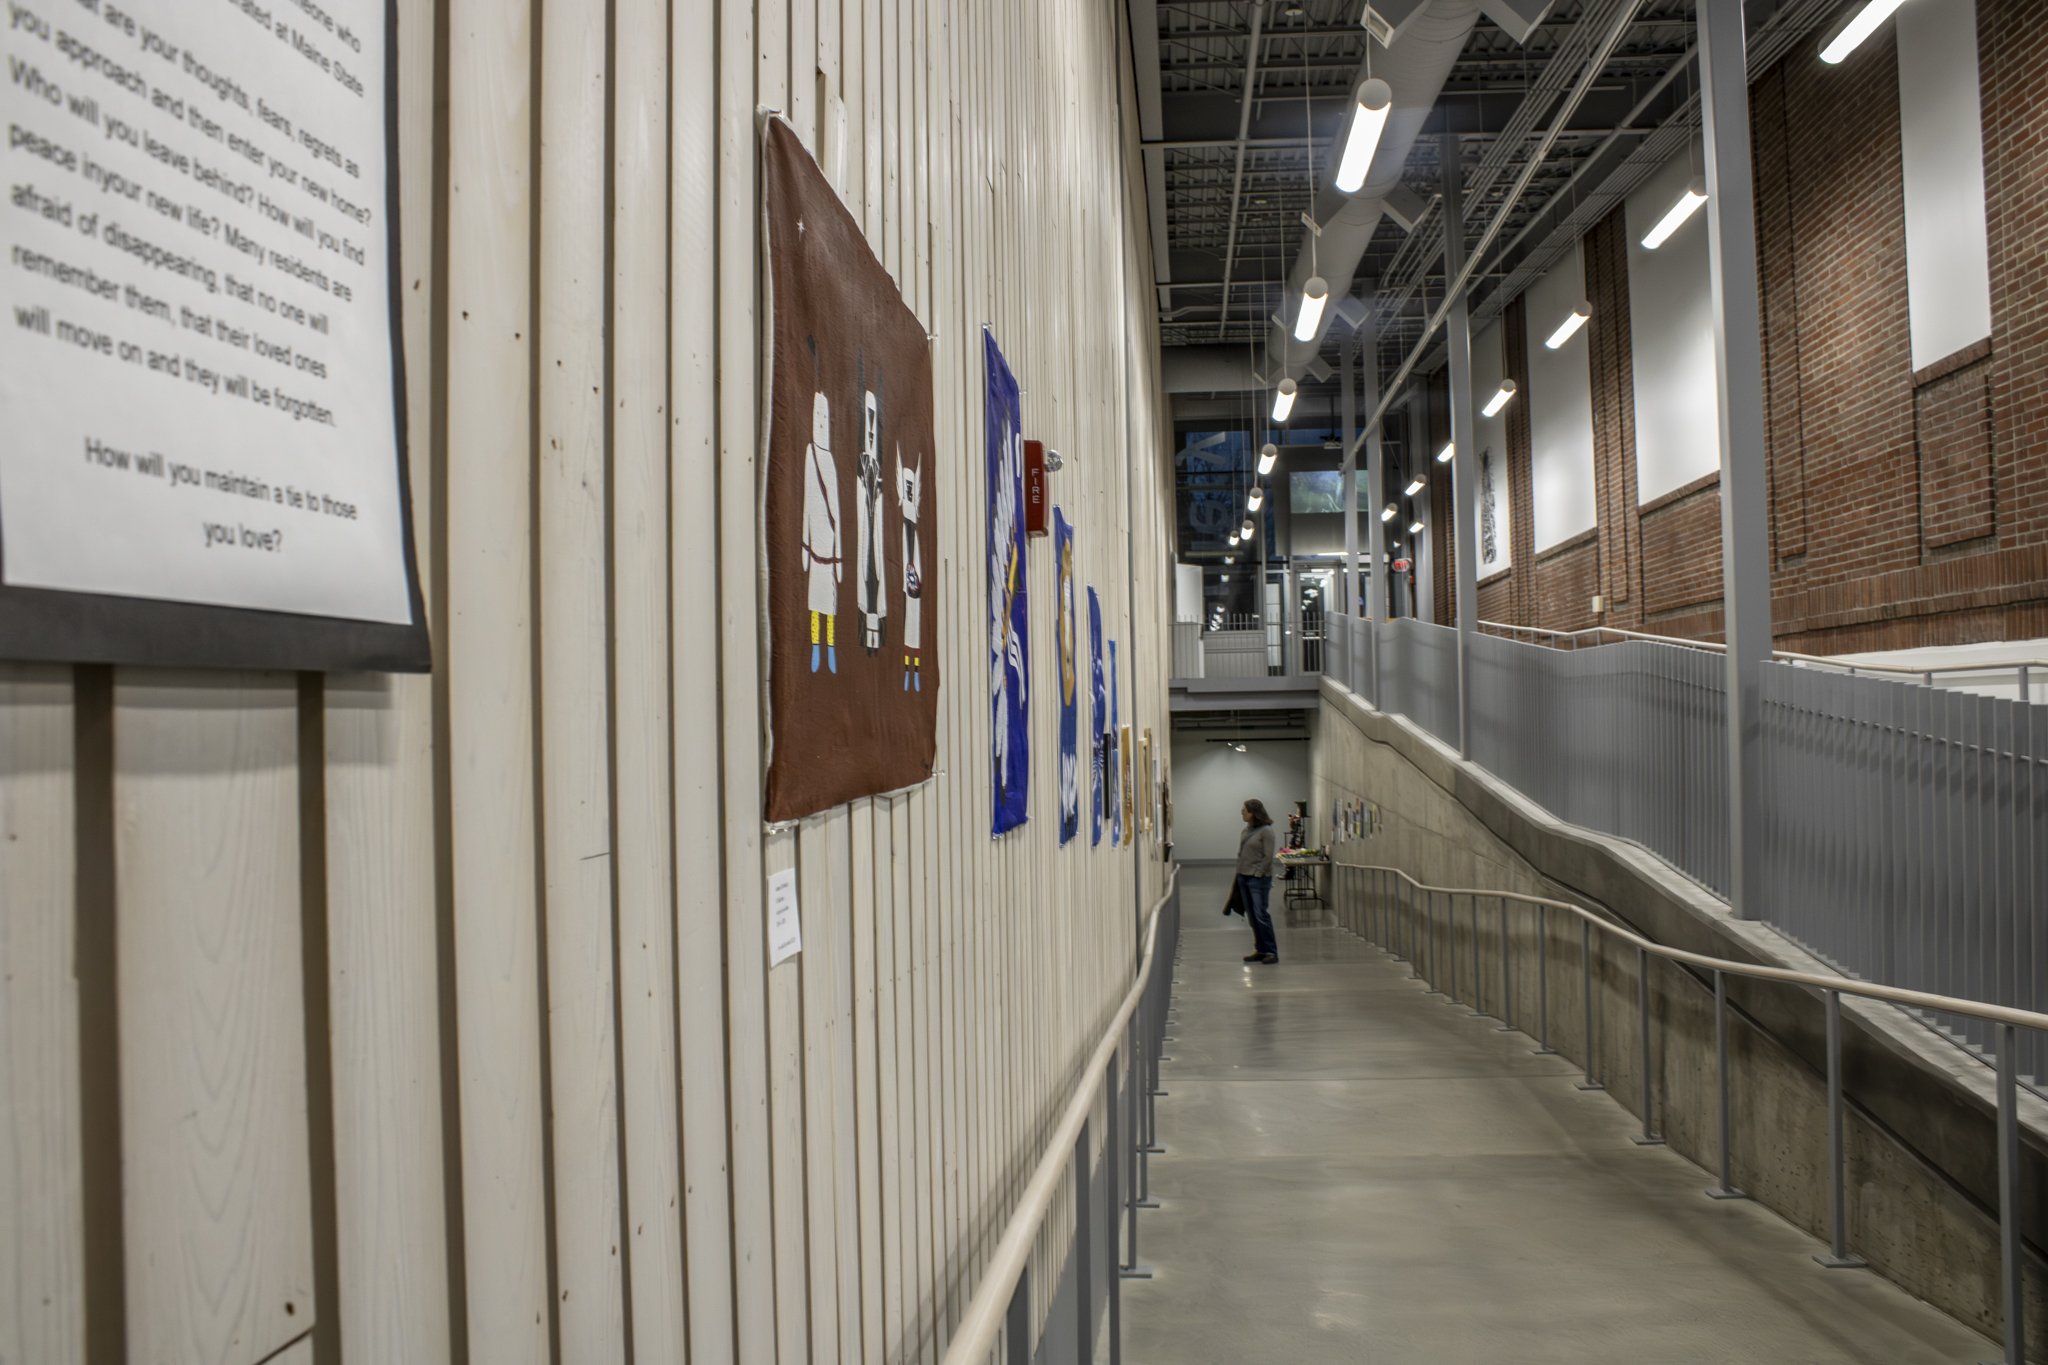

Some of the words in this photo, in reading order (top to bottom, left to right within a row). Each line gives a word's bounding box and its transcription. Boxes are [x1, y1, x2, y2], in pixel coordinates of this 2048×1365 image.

[104, 4, 136, 37] are
[140, 26, 179, 63] your
[182, 50, 252, 115] thoughts,
[257, 98, 295, 141] fears,
[298, 129, 342, 168] regrets
[345, 159, 360, 179] as
[275, 22, 289, 43] at
[291, 29, 330, 73] Maine
[333, 61, 364, 98] State
[336, 24, 361, 53] who
[8, 0, 50, 42] you
[56, 30, 147, 98] approach
[151, 88, 184, 120] and
[188, 106, 223, 142] then
[227, 133, 265, 166] enter
[268, 157, 298, 184] your
[301, 176, 328, 202] new
[331, 189, 372, 226] home?
[9, 55, 62, 106] Who
[66, 94, 99, 126] will
[104, 114, 139, 148] you
[143, 130, 190, 174] leave
[193, 157, 254, 204] behind?
[258, 193, 290, 227] How
[292, 217, 314, 240] will
[317, 230, 340, 253] you
[342, 238, 365, 266] find
[8, 123, 77, 172] peace
[147, 191, 183, 222] new
[186, 205, 220, 238] life?
[224, 223, 265, 265] Many
[269, 250, 330, 292] residents
[332, 281, 352, 302] are
[11, 184, 72, 228] afraid
[78, 213, 99, 238] of
[224, 274, 254, 305] that
[258, 292, 276, 313] no
[280, 301, 305, 325] one
[308, 314, 328, 335] will
[11, 245, 120, 301] remember
[124, 284, 175, 325] them,
[180, 306, 212, 337] that
[215, 320, 250, 349] their
[253, 333, 292, 366] loved
[295, 354, 327, 379] ones
[14, 306, 50, 335] will
[56, 320, 113, 356] move
[118, 341, 142, 364] on
[147, 350, 181, 378] and
[184, 359, 220, 394] they
[223, 375, 248, 398] will
[251, 380, 271, 406] be
[273, 387, 335, 426] forgotten.
[85, 437, 130, 470] How
[134, 452, 164, 477] will
[168, 463, 201, 487] you
[204, 470, 270, 500] maintain
[274, 487, 284, 504] a
[286, 486, 303, 509] tie
[305, 491, 320, 512] to
[322, 494, 357, 520] those
[203, 523, 236, 548] you
[239, 524, 282, 552] love?
[1031, 468, 1041, 504] FIRE
